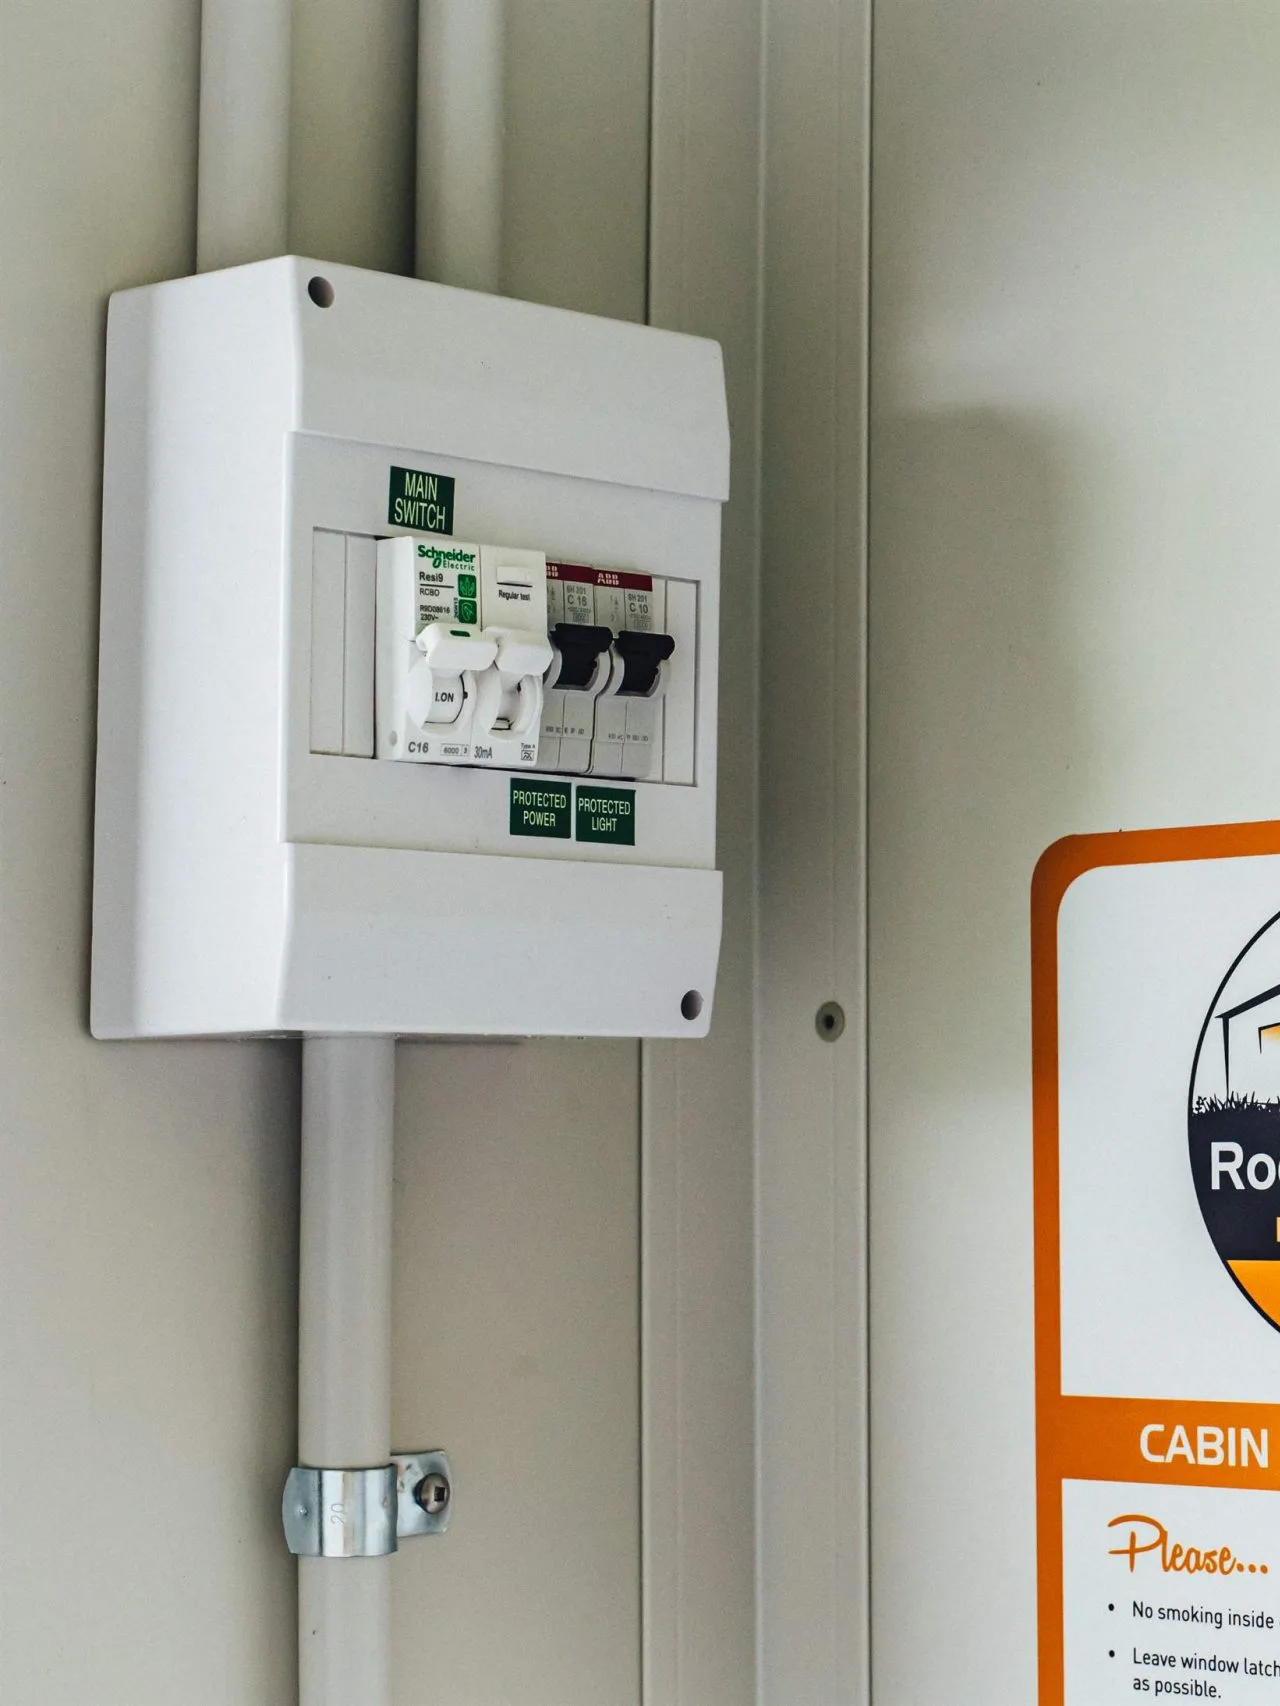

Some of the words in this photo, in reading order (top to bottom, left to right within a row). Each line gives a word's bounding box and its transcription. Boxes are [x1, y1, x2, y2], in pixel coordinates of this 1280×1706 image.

[405, 472, 437, 501] MAIN
[394, 497, 446, 530] SWITCH
[417, 544, 476, 564] Schneider
[443, 560, 475, 571] Electric
[419, 571, 444, 582] Resi9
[597, 572, 620, 585] ABB
[419, 588, 440, 597] RCBO
[498, 590, 519, 600] Regular
[520, 592, 531, 601] test
[567, 594, 575, 605] C
[629, 602, 636, 612] C
[639, 604, 649, 614] 10
[408, 741, 429, 753] C16
[474, 746, 493, 759] 30mA
[512, 790, 567, 809] PROTECTED
[578, 797, 631, 815] PROTECTED
[523, 810, 556, 827] POWER
[591, 816, 618, 832] LIGHT
[1139, 1424, 1269, 1468] CABIN
[1107, 1514, 1269, 1576] Please...
[1132, 1600, 1153, 1618] No
[1158, 1604, 1223, 1629] smoking
[1228, 1608, 1274, 1629] inside
[1133, 1648, 1176, 1668] Leave
[1181, 1653, 1239, 1673] window
[1133, 1678, 1150, 1691] as
[1155, 1679, 1222, 1698] possible.
